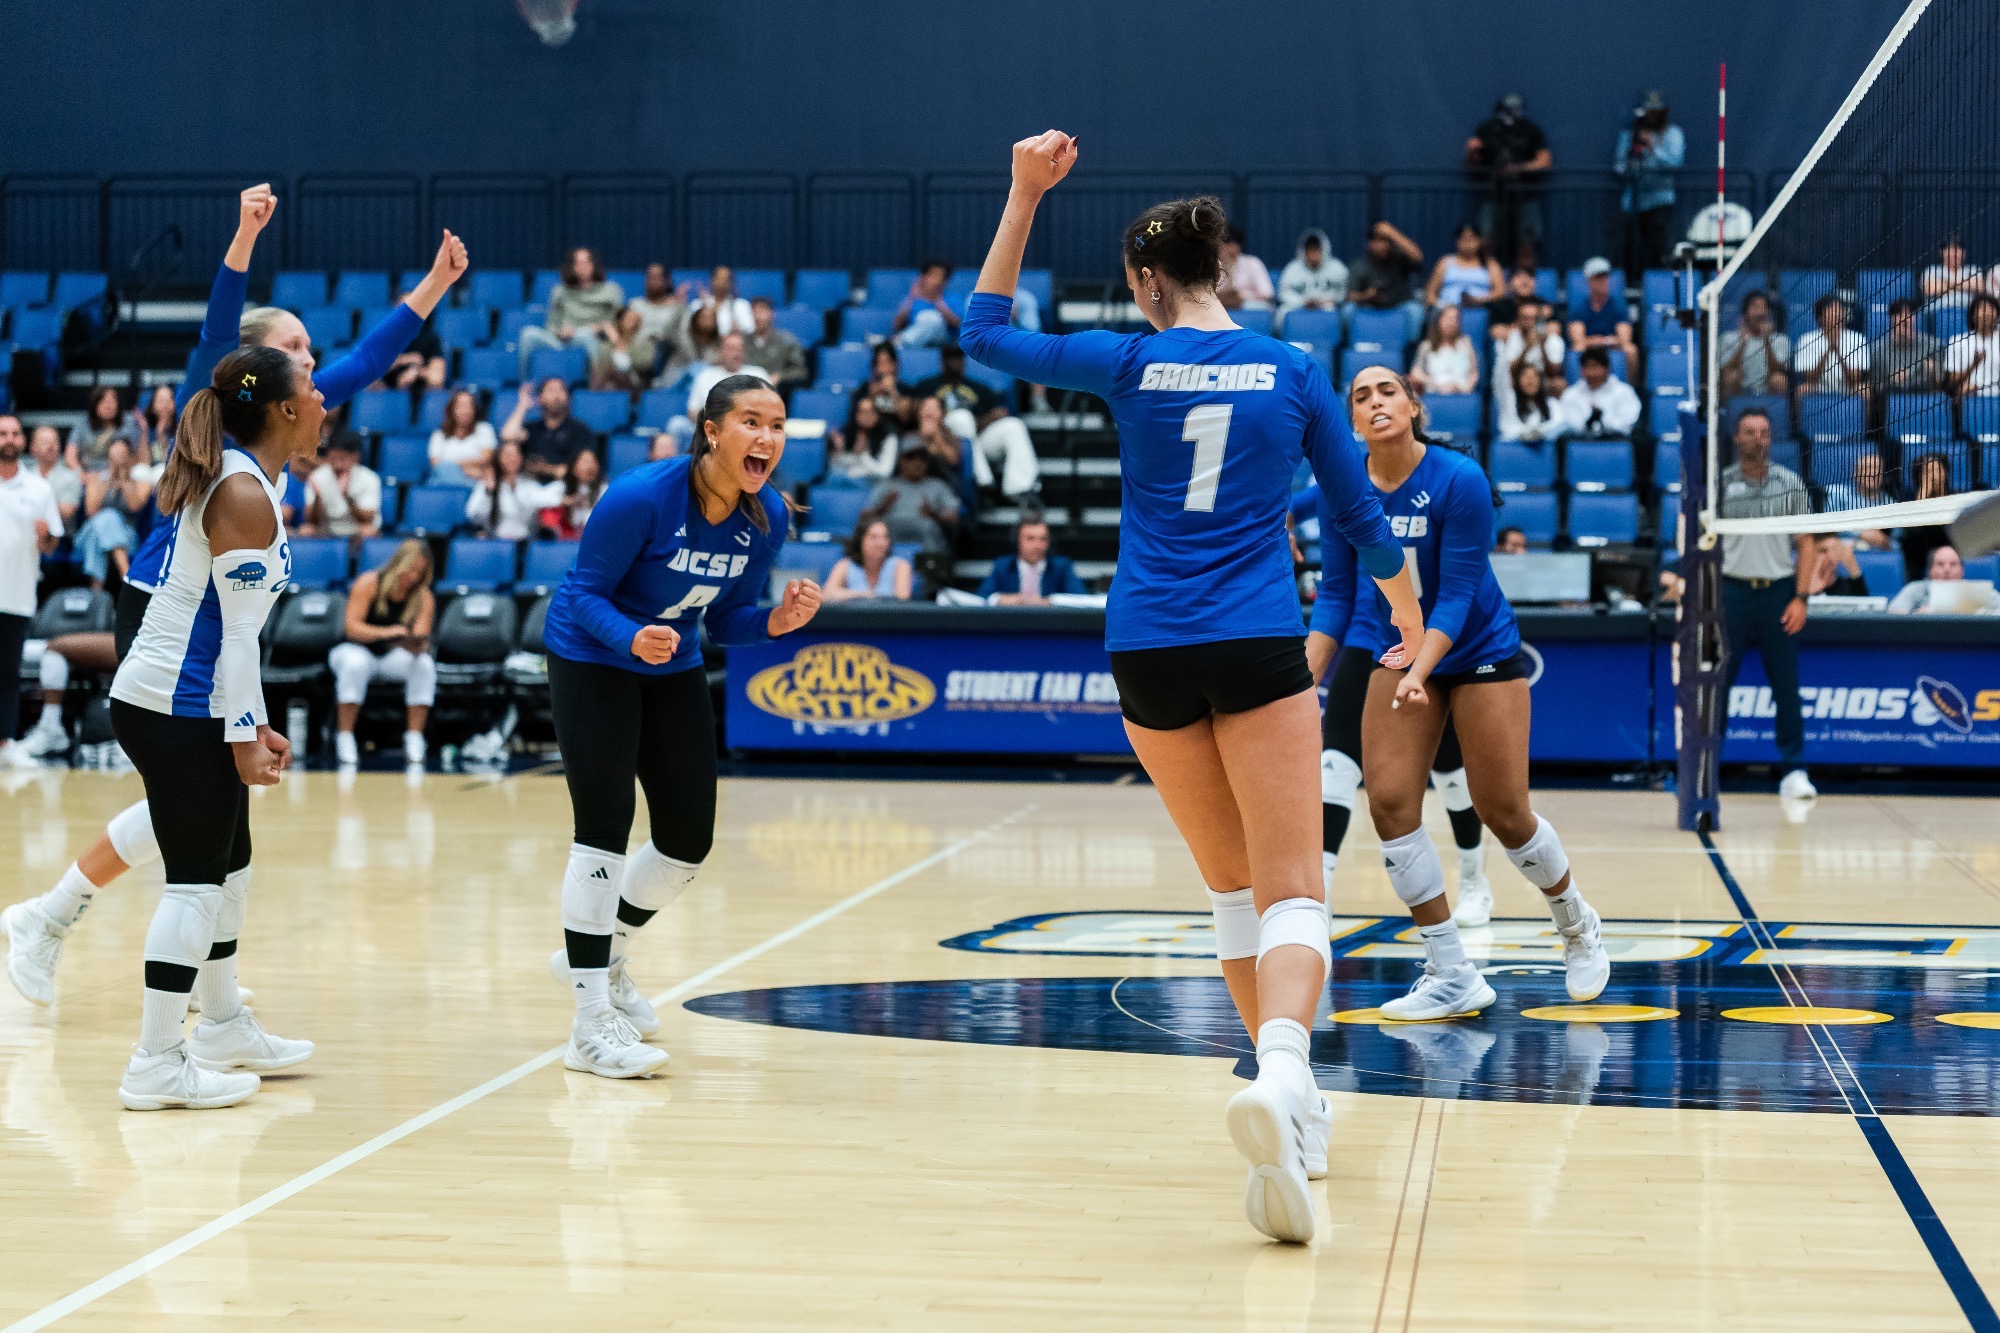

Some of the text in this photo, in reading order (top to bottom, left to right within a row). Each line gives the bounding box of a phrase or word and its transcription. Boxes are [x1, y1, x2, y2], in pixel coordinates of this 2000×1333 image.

[1138, 362, 1277, 392] GAUCHOS
[1181, 403, 1234, 513] 1
[667, 547, 749, 579] UCSB
[944, 670, 1040, 702] STUDENT
[1040, 671, 1083, 702] FAN
